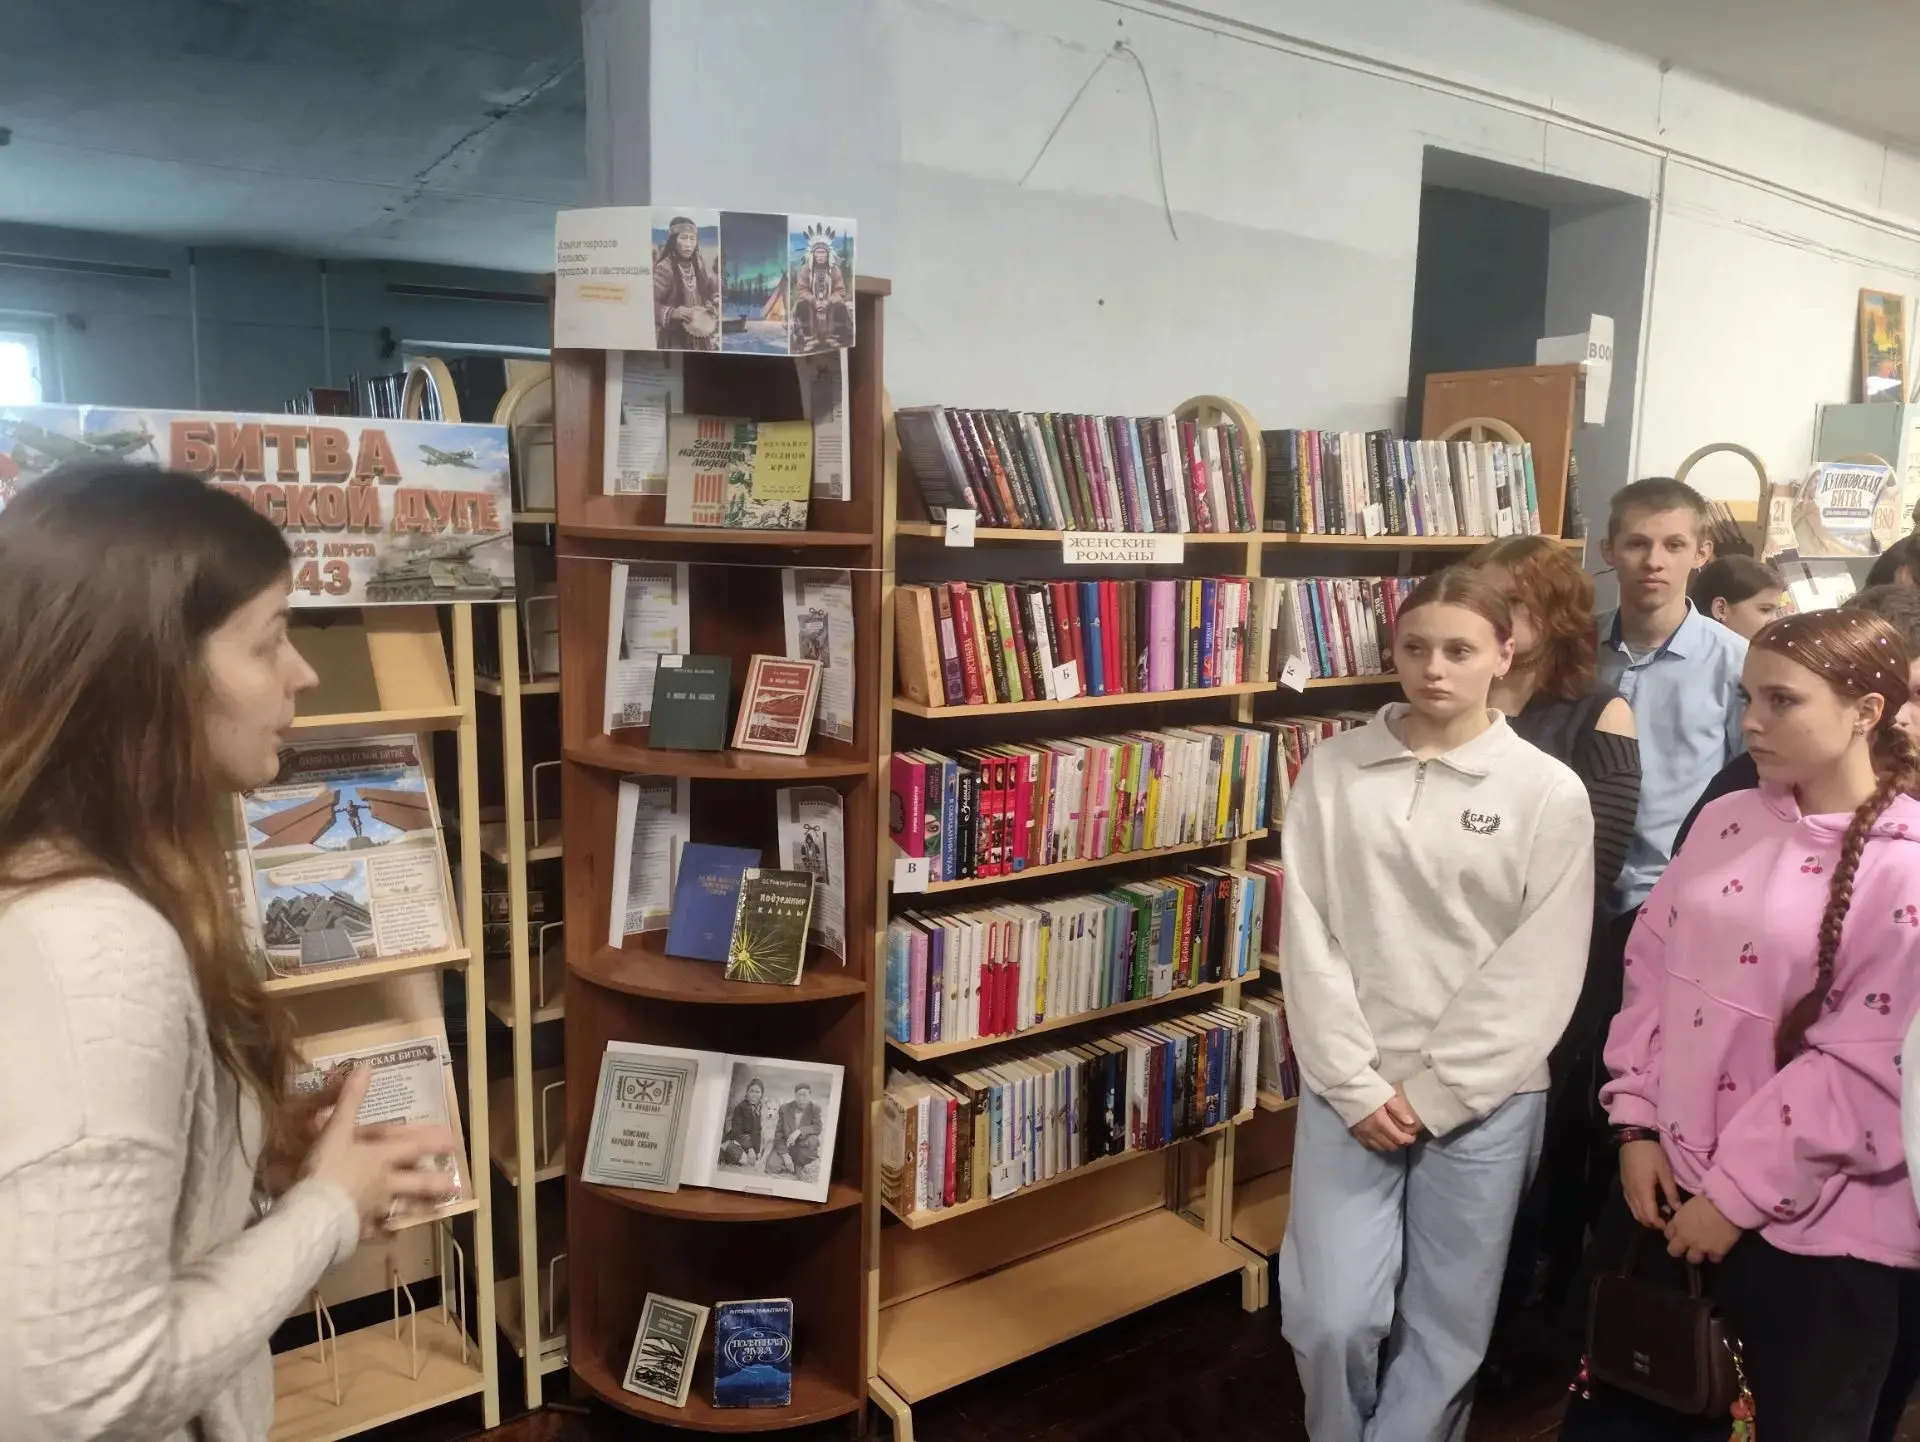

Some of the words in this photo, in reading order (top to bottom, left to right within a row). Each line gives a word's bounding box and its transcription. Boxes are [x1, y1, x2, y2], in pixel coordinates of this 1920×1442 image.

[694, 439, 731, 449] Земля
[170, 421, 402, 484] БИТВА
[692, 459, 728, 471] людей
[1821, 472, 1882, 495] КУЛИКОВСКАЯ
[220, 477, 382, 534] СКОЙ
[391, 487, 502, 533] ДУГЕ
[1831, 489, 1863, 507] БИТВА
[294, 540, 318, 557] 23
[322, 543, 376, 557] АВГУСТА
[1069, 538, 1156, 548] ЖЕНСКИЕ
[1076, 551, 1154, 561] РОМАНЫ
[1374, 597, 1383, 615] ВЕК
[964, 637, 977, 674] АРСЕНЬЕВА
[908, 862, 917, 873] В
[758, 907, 804, 917] КЛАДЫ
[398, 1048, 428, 1061] БИТВА
